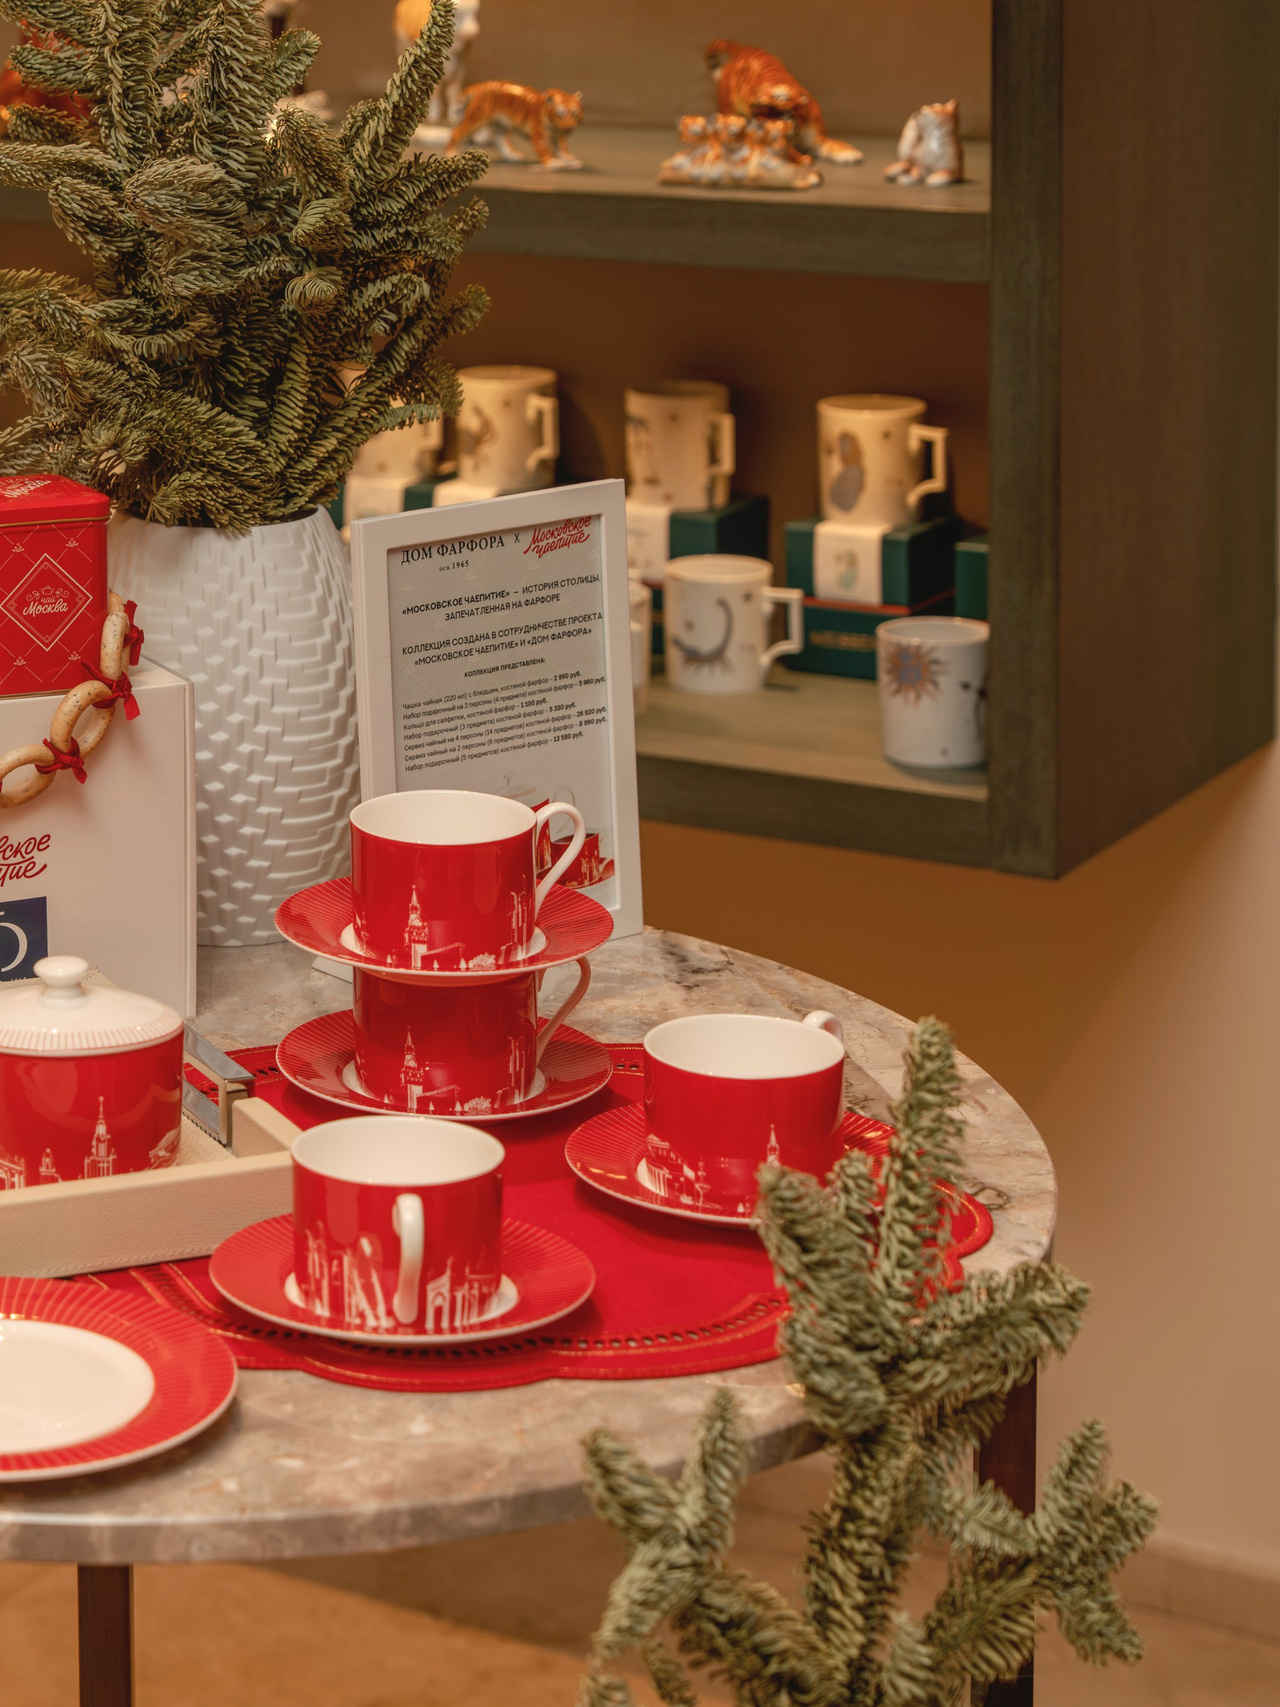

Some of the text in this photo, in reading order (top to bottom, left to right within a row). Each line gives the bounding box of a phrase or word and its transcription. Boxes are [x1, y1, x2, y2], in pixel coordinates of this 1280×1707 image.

[401, 545, 433, 566] ДОМ
[436, 534, 505, 557] ФАРФОРА
[523, 515, 592, 555] Московское
[452, 560, 469, 570] 1965
[22, 598, 69, 617] Москва
[402, 597, 463, 615] «МОСКОВСКОЕ
[464, 590, 510, 605] ЧАЕПИТИЕ»
[522, 580, 559, 595] ИСТОРИЯ
[445, 593, 561, 621] ЗАПЕЧАТЛЕННАЯ НА ФАРФОРЕ
[402, 612, 603, 656] КОЛЛЕКЦИЯ СОЗДАНА В СОТРУДНИЧЕСТВЕ ПРОЕКТА
[414, 627, 592, 666] «МОСКОВСКОЕ ЧАЕПИТИЕ» И «ДОМ ФАРФОРА»
[464, 658, 546, 678] КОЛЛЕКЦИЯ ПРЕДСТАВЛЕНА:
[527, 677, 549, 687] фарфор
[403, 712, 421, 720] Набор
[421, 705, 456, 717] подарочный
[553, 683, 574, 692] фарфор
[403, 722, 425, 730] Кольцо
[493, 705, 516, 714] фарфор
[403, 733, 423, 741] Набор
[423, 725, 459, 737] подарочный
[522, 709, 545, 719] фарфор
[404, 743, 425, 751] Сервиз
[404, 753, 426, 762] Сервиз
[405, 763, 424, 772] Набор
[424, 756, 460, 768] подарочный
[527, 738, 549, 748] фарфор
